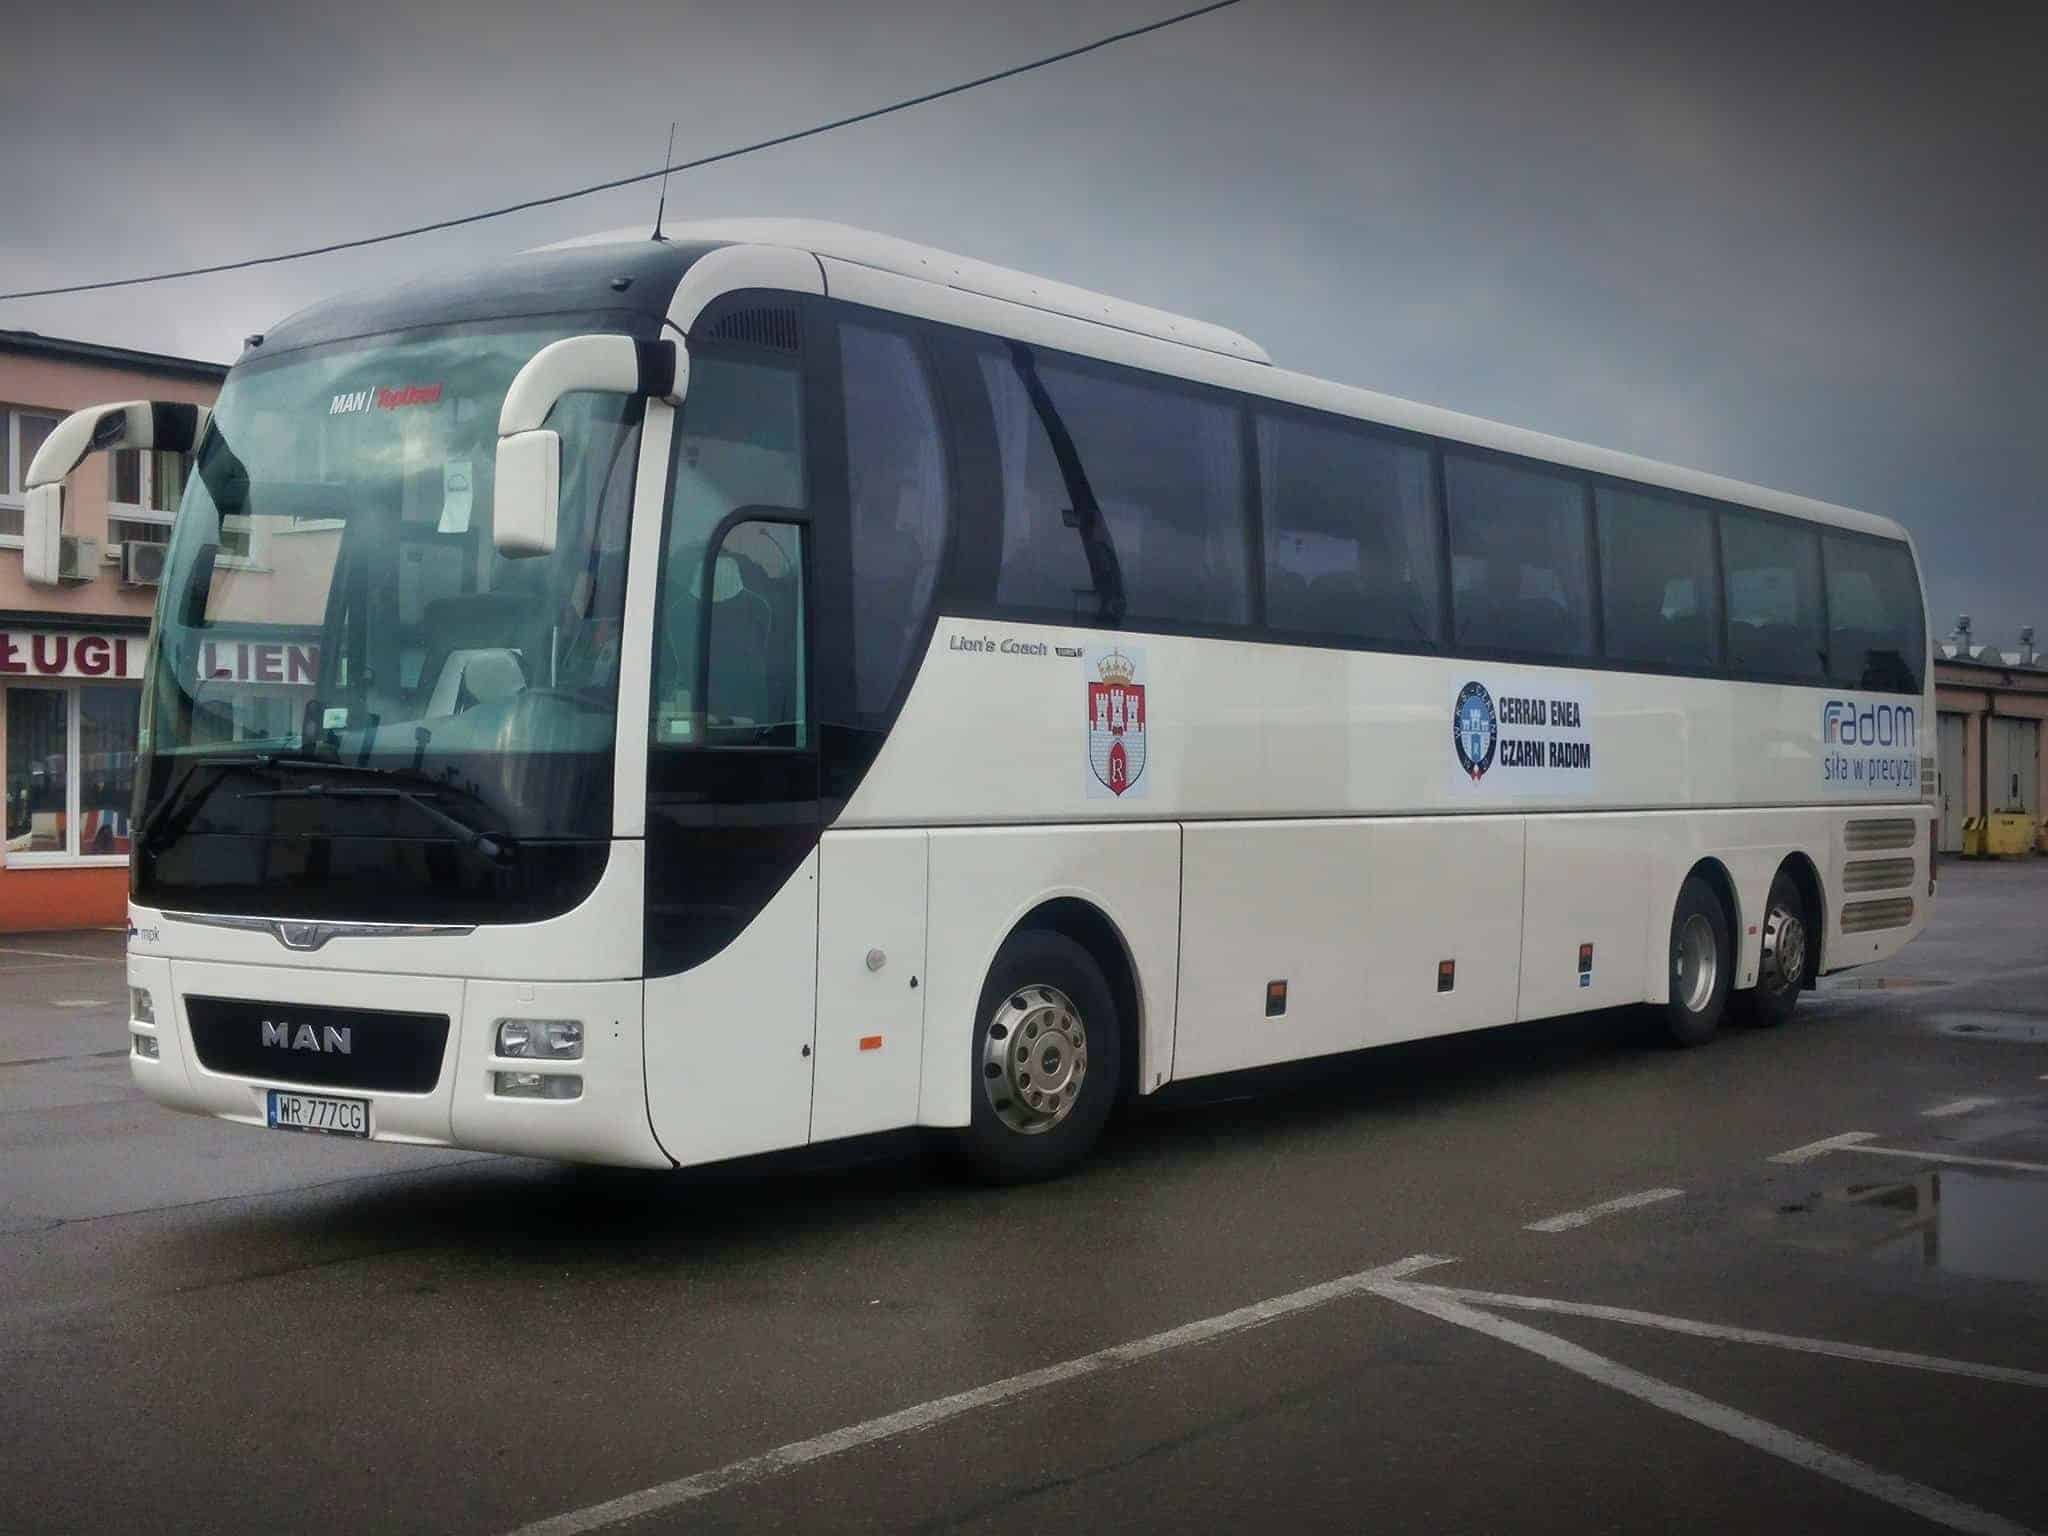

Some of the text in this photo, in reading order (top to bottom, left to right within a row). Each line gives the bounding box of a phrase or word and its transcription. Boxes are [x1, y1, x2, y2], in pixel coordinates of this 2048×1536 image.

[329, 391, 367, 415] MAN
[950, 635, 996, 653] Lion's
[1000, 638, 1048, 656] Coach
[1499, 697, 1547, 726] CERRAD
[1551, 701, 1581, 728] ENEA
[1500, 740, 1545, 768] CZARNI
[1549, 742, 1591, 769] RADOM
[1824, 752, 1848, 780] siła
[1853, 760, 1864, 780] w
[262, 1021, 351, 1054] MAN
[280, 1097, 301, 1123] WR
[308, 1101, 361, 1129] 777CG
